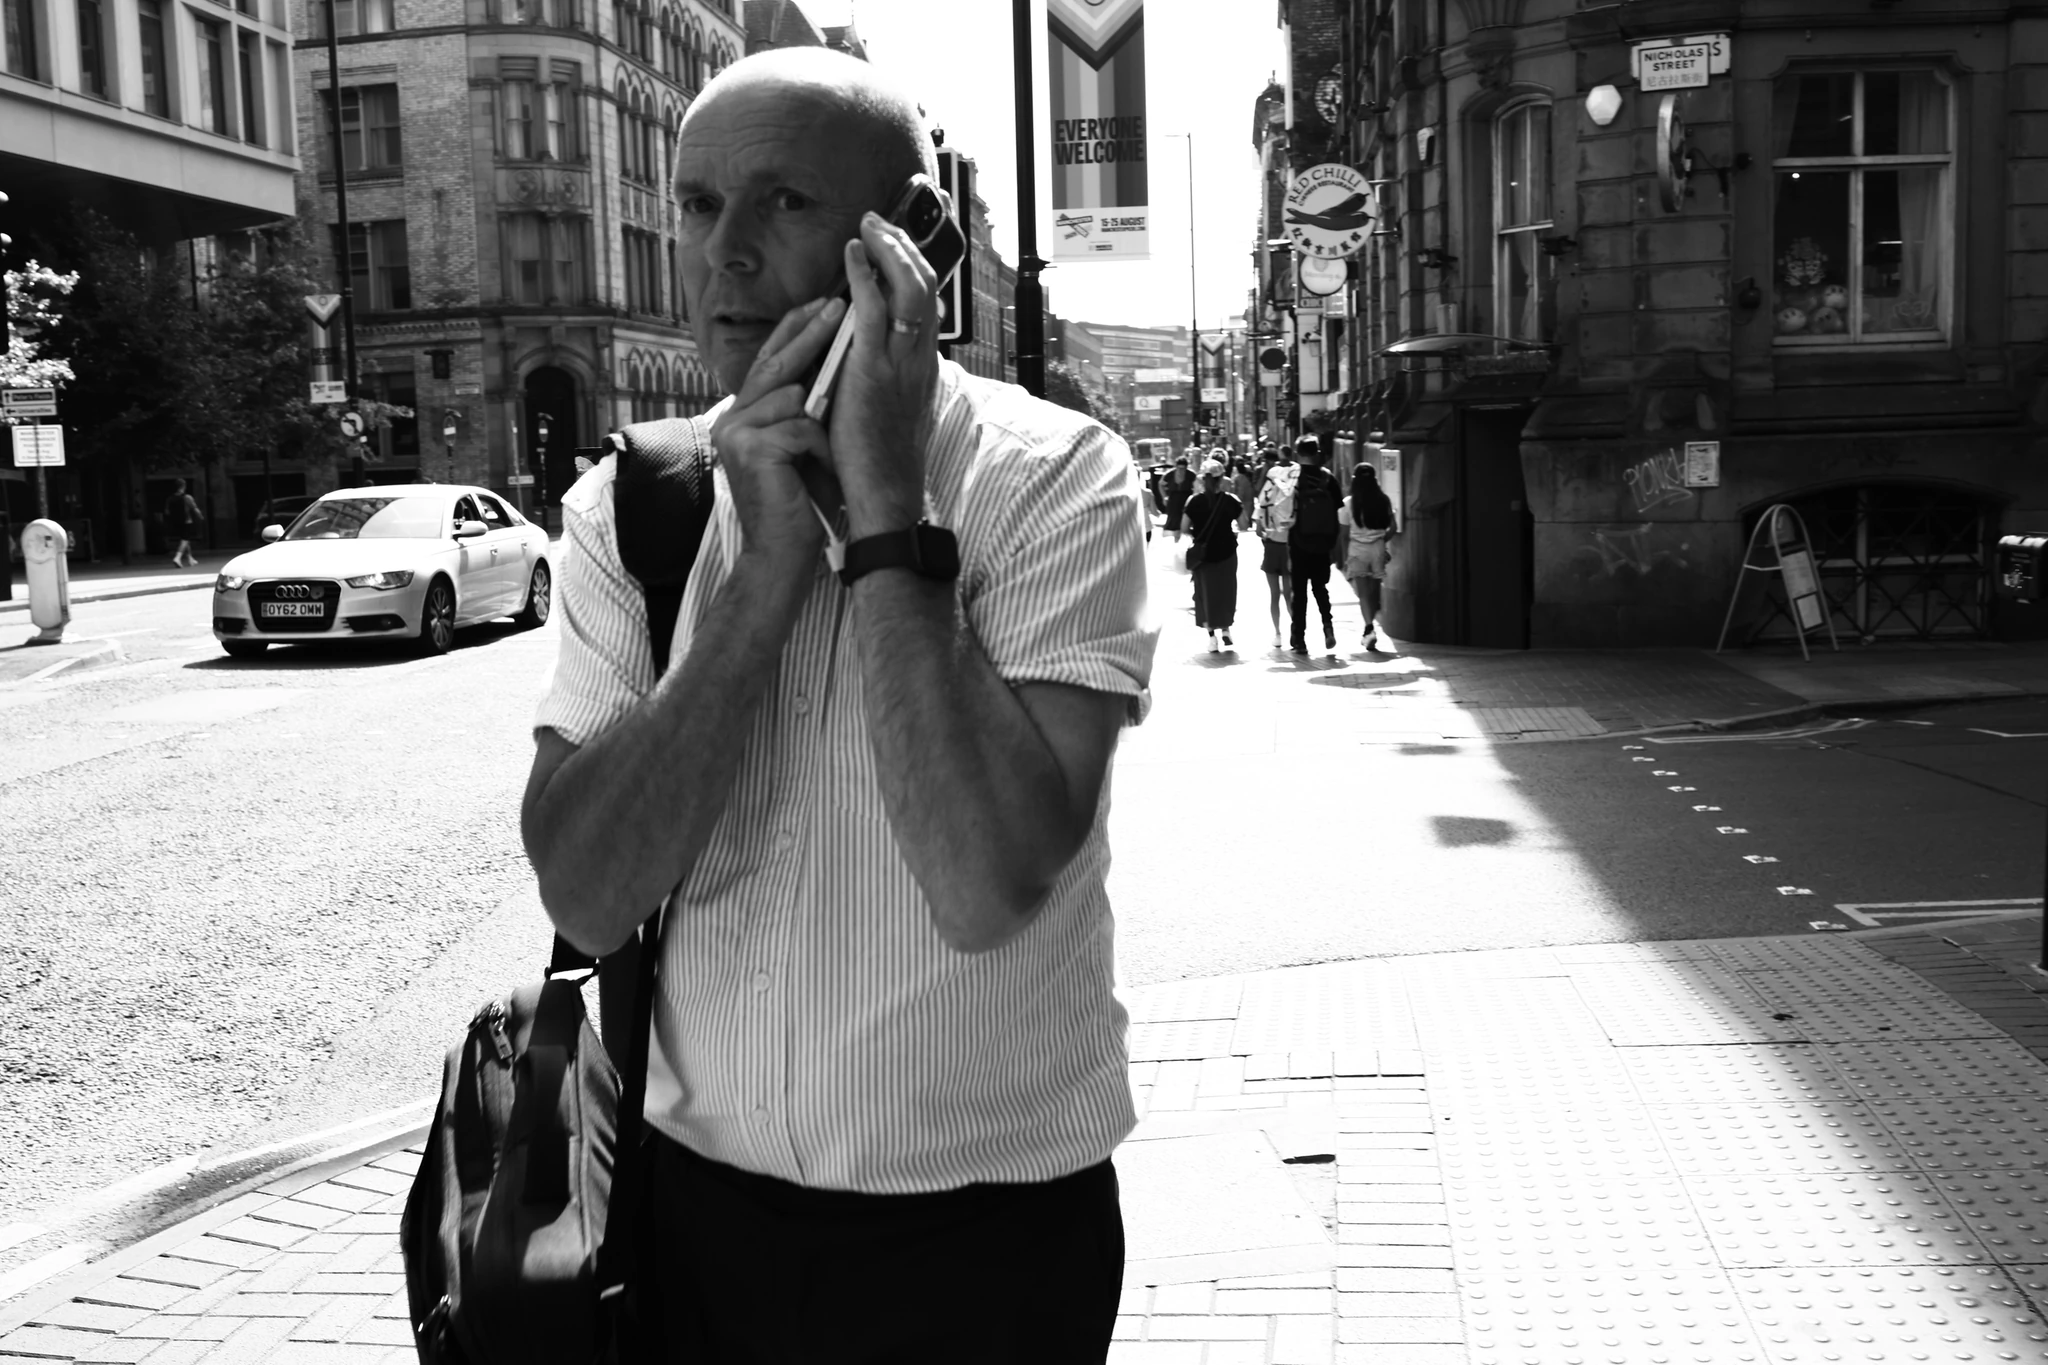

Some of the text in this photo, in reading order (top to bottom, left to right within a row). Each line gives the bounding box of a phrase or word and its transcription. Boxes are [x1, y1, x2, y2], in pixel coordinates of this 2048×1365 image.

[1644, 48, 1703, 61] NICHOLAS
[1653, 59, 1696, 72] STREET
[1055, 116, 1142, 142] EVERYONE
[1054, 140, 1145, 165] WELCOME
[1288, 167, 1362, 204] RED CHILLI
[1120, 217, 1145, 226] AUGUST
[268, 603, 322, 615] OY62 OMW
